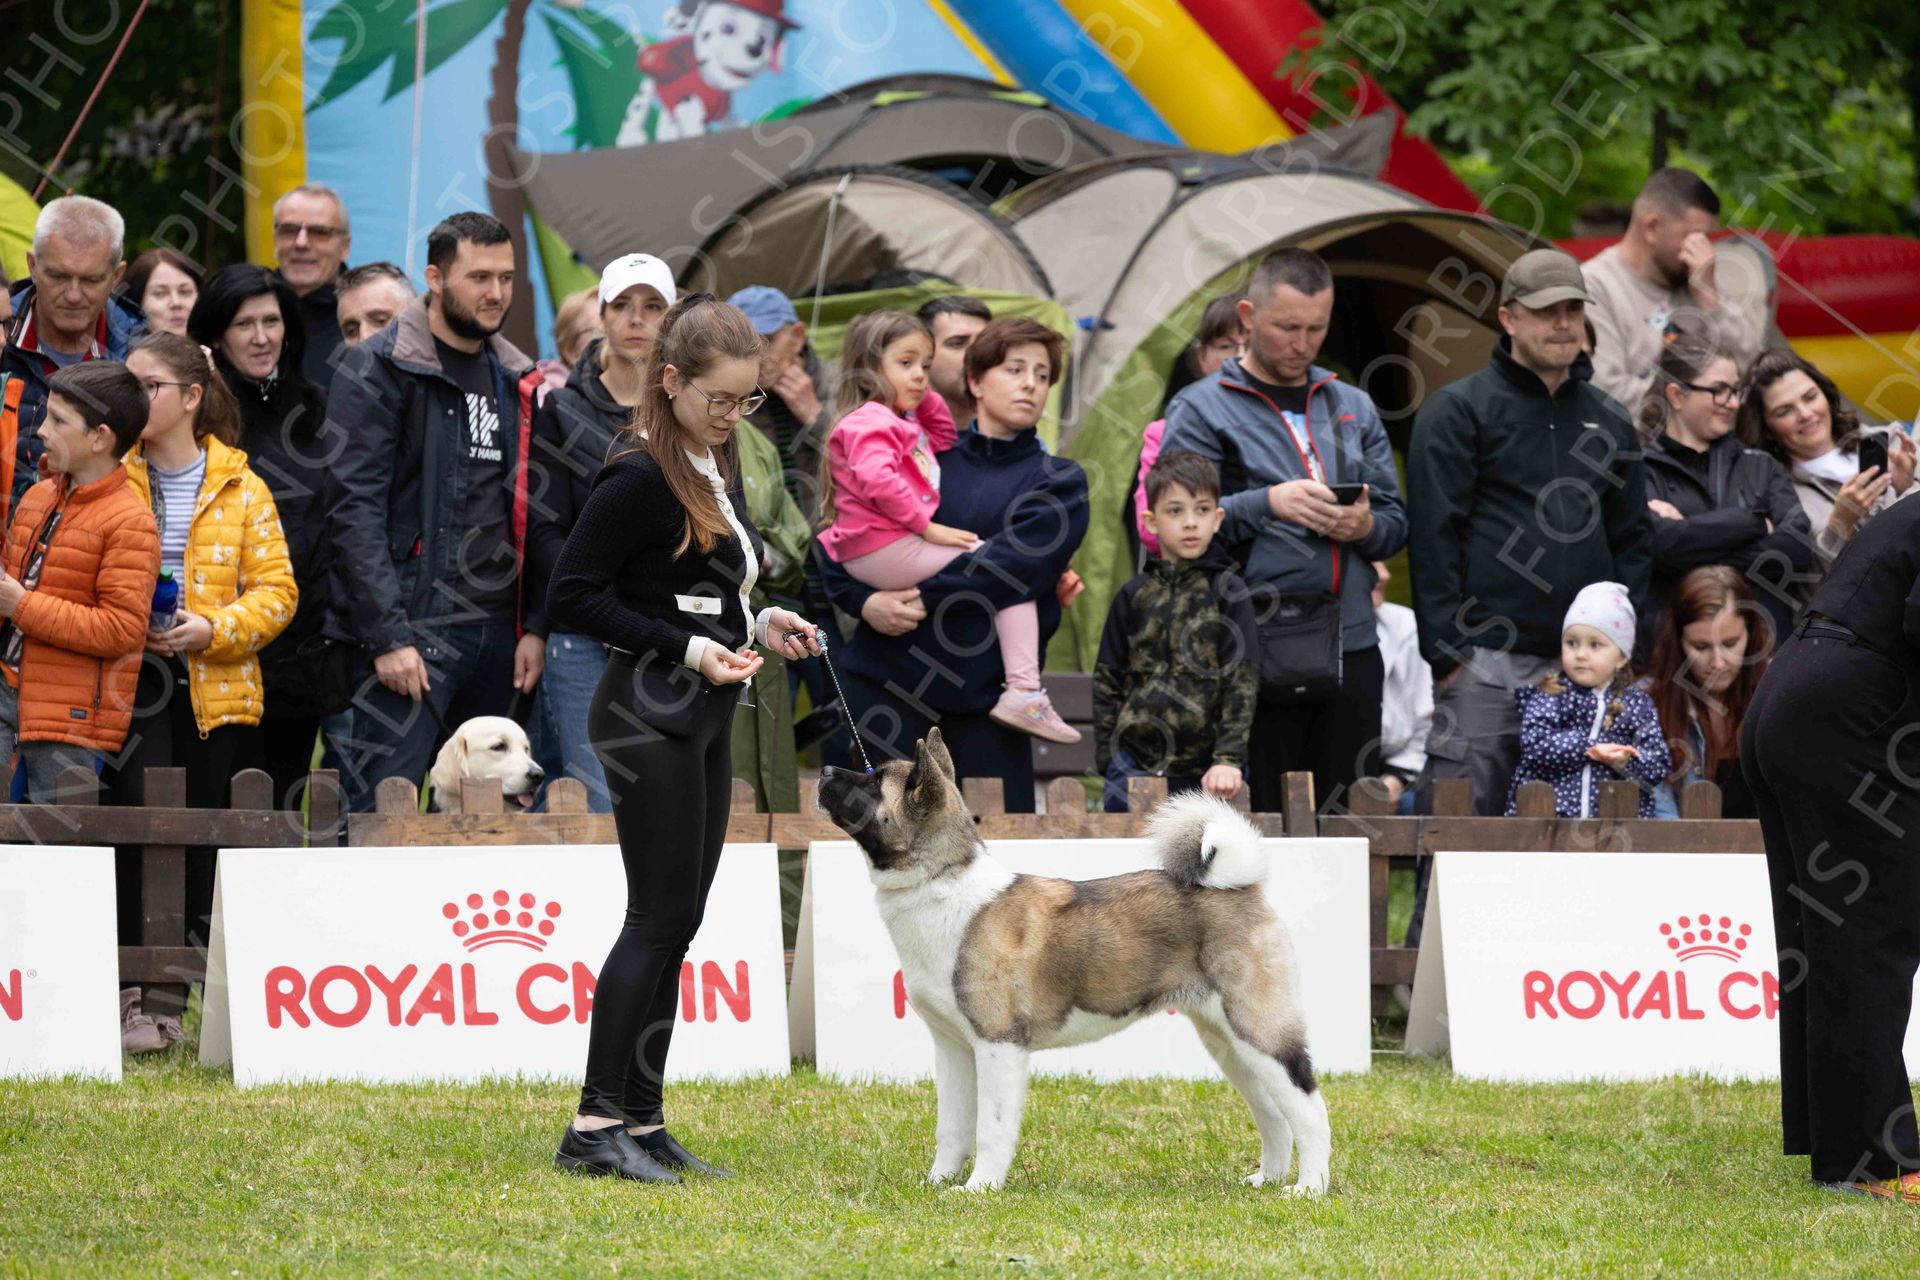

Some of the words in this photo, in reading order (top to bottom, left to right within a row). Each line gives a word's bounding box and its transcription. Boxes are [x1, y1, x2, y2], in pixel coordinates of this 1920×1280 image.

[265, 963, 499, 1028] ROYAL
[516, 960, 751, 1024] CAIN
[1524, 970, 1704, 1020] ROYAL
